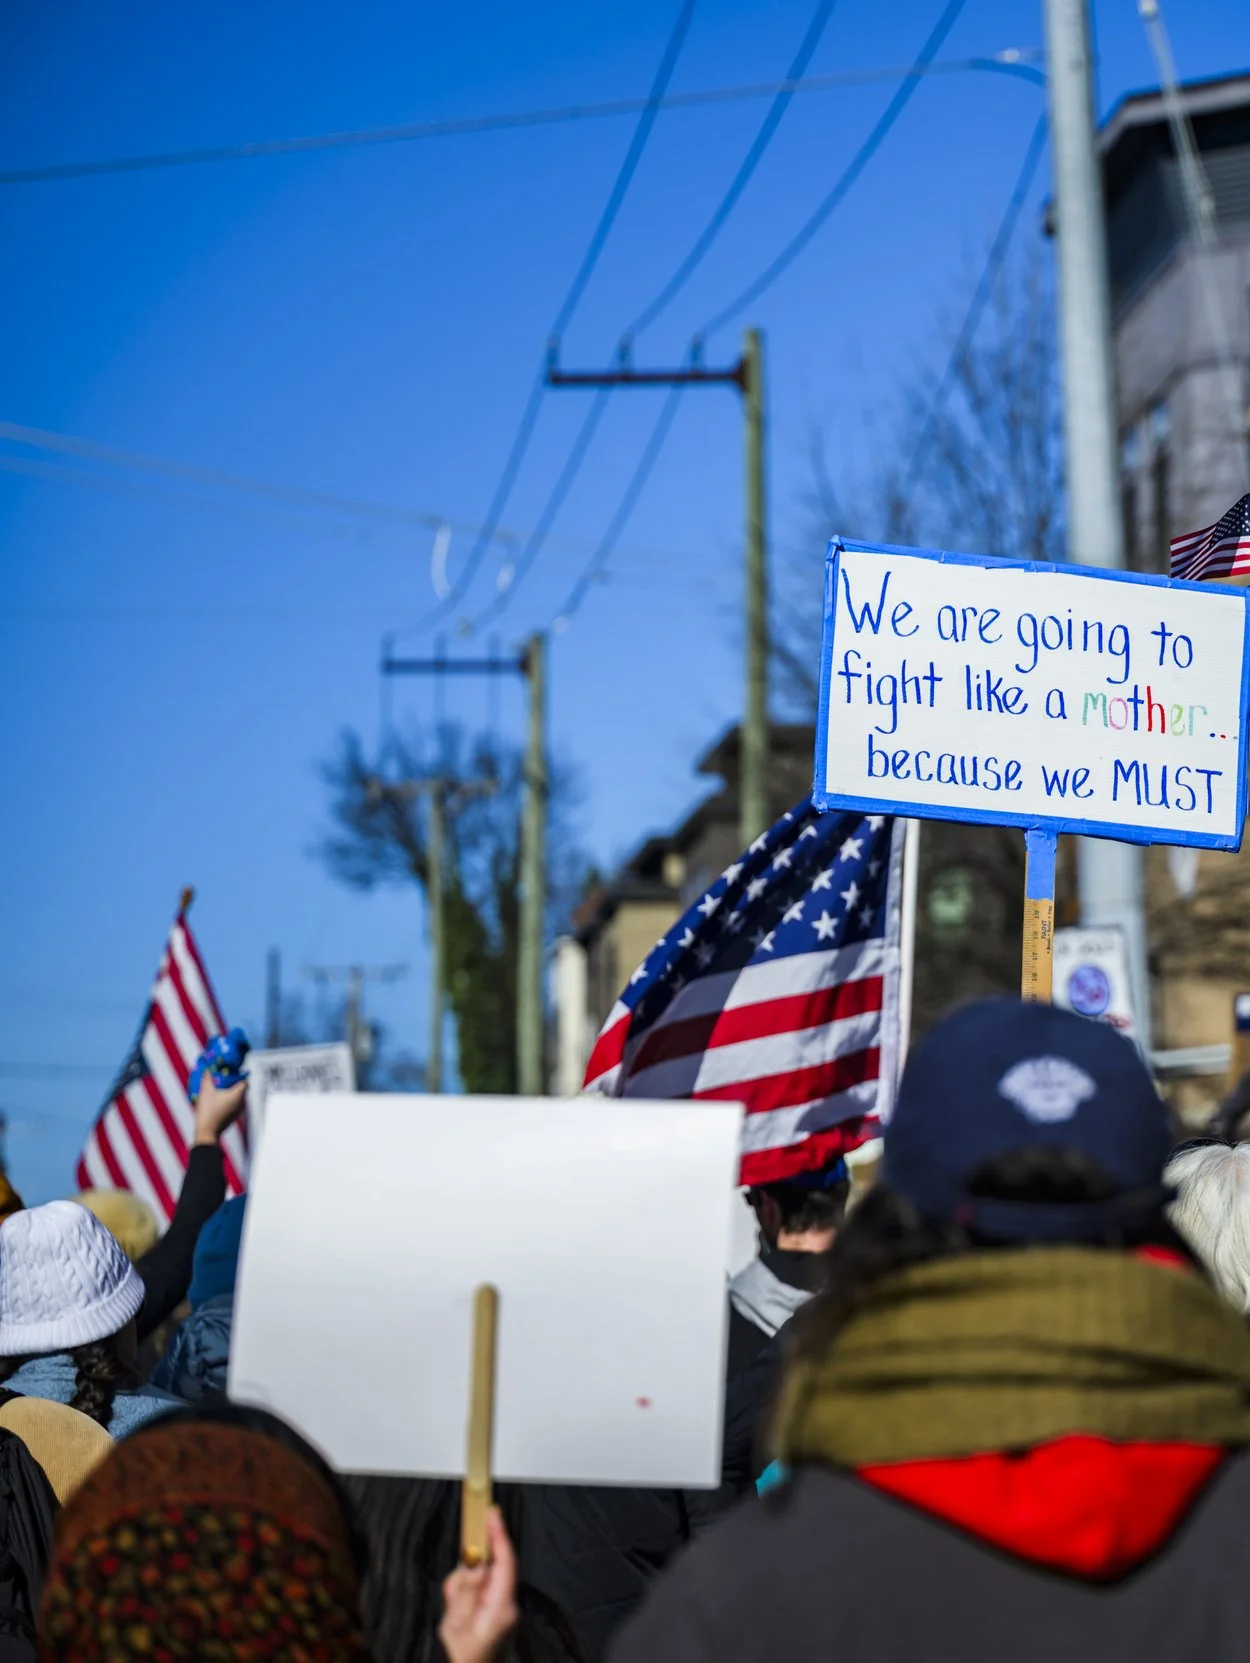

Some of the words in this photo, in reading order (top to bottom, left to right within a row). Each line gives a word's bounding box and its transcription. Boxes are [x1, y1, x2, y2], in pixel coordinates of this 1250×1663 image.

[841, 568, 920, 635] We
[937, 604, 1003, 644] are
[1015, 609, 1131, 685] going
[1150, 621, 1194, 669] to
[838, 649, 943, 735] fight
[965, 664, 1029, 716] like
[1045, 688, 1068, 720] a
[867, 734, 1023, 792] because
[1041, 764, 1095, 799] we
[1112, 759, 1224, 814] MUST
[1032, 952, 1037, 960] 17
